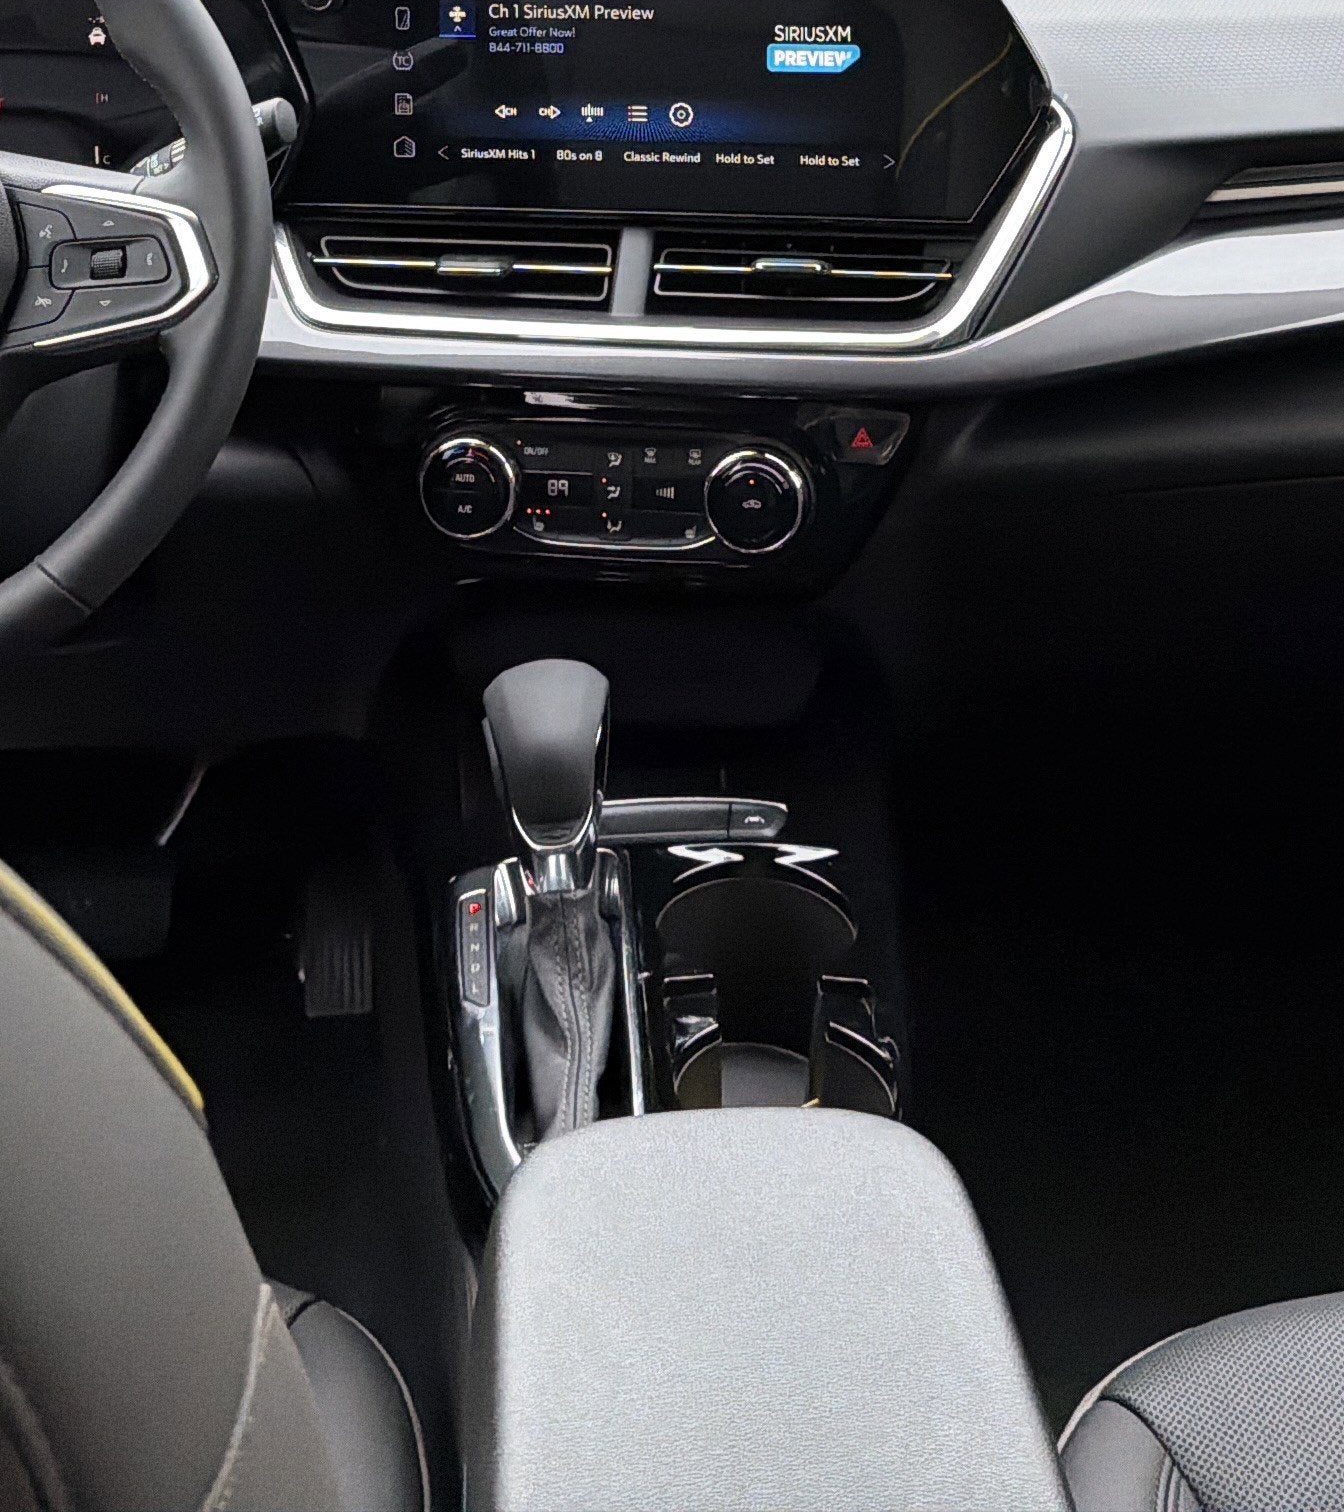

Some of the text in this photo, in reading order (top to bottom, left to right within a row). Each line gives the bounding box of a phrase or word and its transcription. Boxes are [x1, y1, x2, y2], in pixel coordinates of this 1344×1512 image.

[488, 3, 655, 20] Ch 1 SiriusXM Preview
[489, 26, 576, 38] Great Offer Now!
[774, 50, 853, 67] PREVIEW
[460, 148, 536, 160] SiriusXM Hits 1
[556, 150, 603, 161] 80s on 8
[623, 152, 701, 163] Classic Rewind
[715, 153, 775, 165] Hold to Set
[800, 155, 860, 167] Hold to Set
[455, 473, 475, 483] AUTO
[547, 479, 569, 497] 89
[457, 504, 472, 514] A/C
[469, 902, 481, 915] P
[470, 943, 480, 952] N
